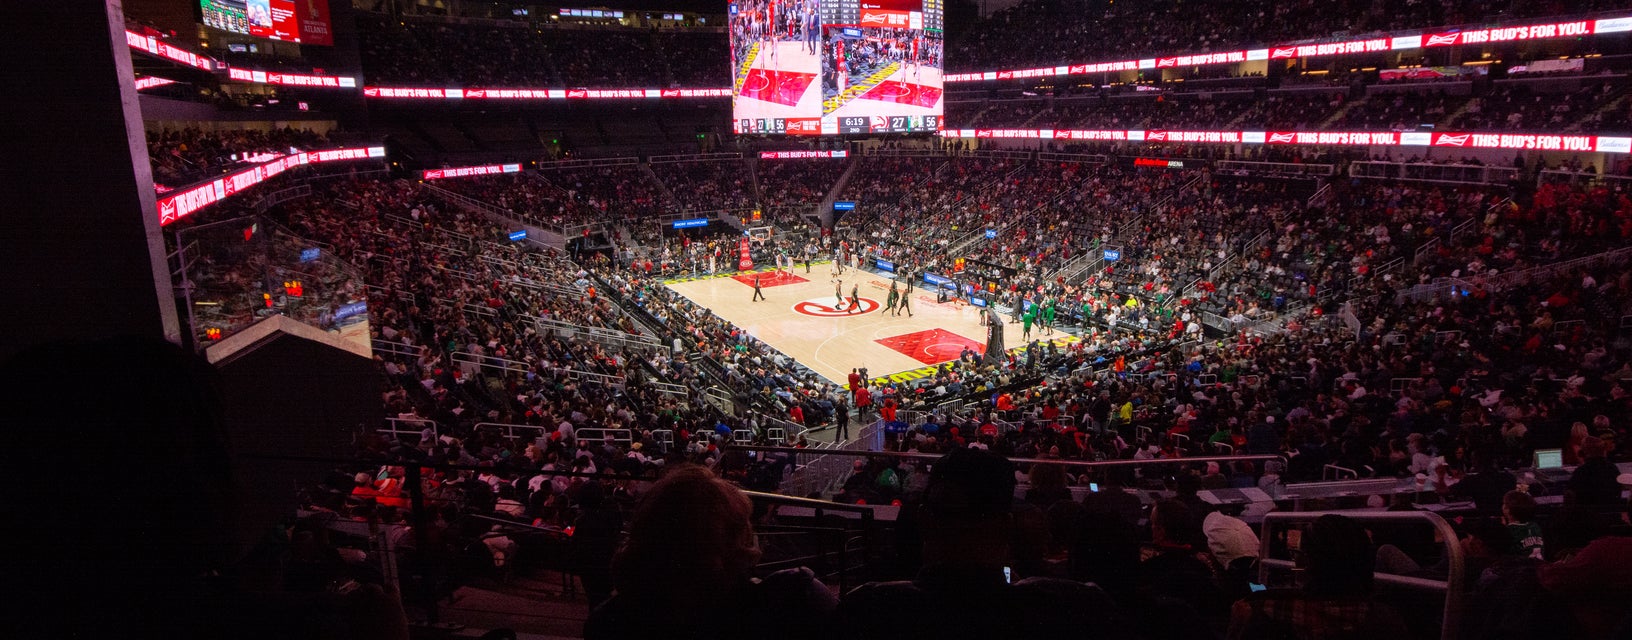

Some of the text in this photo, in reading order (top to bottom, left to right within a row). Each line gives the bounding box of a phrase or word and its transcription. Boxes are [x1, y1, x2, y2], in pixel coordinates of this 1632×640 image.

[304, 26, 327, 34] ATLANTA
[1462, 32, 1488, 44] THIS
[1490, 27, 1528, 42] BUD'S
[1529, 24, 1557, 38] FOR
[1558, 22, 1590, 35] YOU.
[1297, 45, 1316, 56] THIS
[1317, 43, 1344, 55] BUD'S
[1345, 41, 1365, 53] FOR
[1366, 39, 1389, 51] YOU.
[1178, 52, 1244, 66] THIS BUD'S FOR YOU.
[1097, 63, 1112, 71] BUD'S
[1113, 62, 1124, 70] FOR
[1124, 61, 1137, 69] YOU.
[282, 75, 337, 86] THIS BUD'S FOR YOU.
[379, 88, 394, 96] THIS
[395, 89, 414, 97] BUD'S
[415, 89, 428, 97] FOR
[758, 120, 764, 129] 27
[776, 120, 784, 129] 56
[893, 118, 904, 127] 27
[926, 118, 935, 127] 56
[1112, 131, 1126, 139] YOU.
[1168, 132, 1239, 142] THIS BUD'S FOR YOU.
[1296, 132, 1318, 143] THIS
[1318, 133, 1348, 144] BUD'S
[1350, 133, 1369, 144] FOR
[1371, 133, 1396, 144] YOU.
[1472, 134, 1499, 148] THIS
[1501, 135, 1536, 149] BUD'S
[1536, 135, 1560, 150] FOR
[1563, 136, 1592, 150] YOU.
[457, 168, 473, 176] BUD'S
